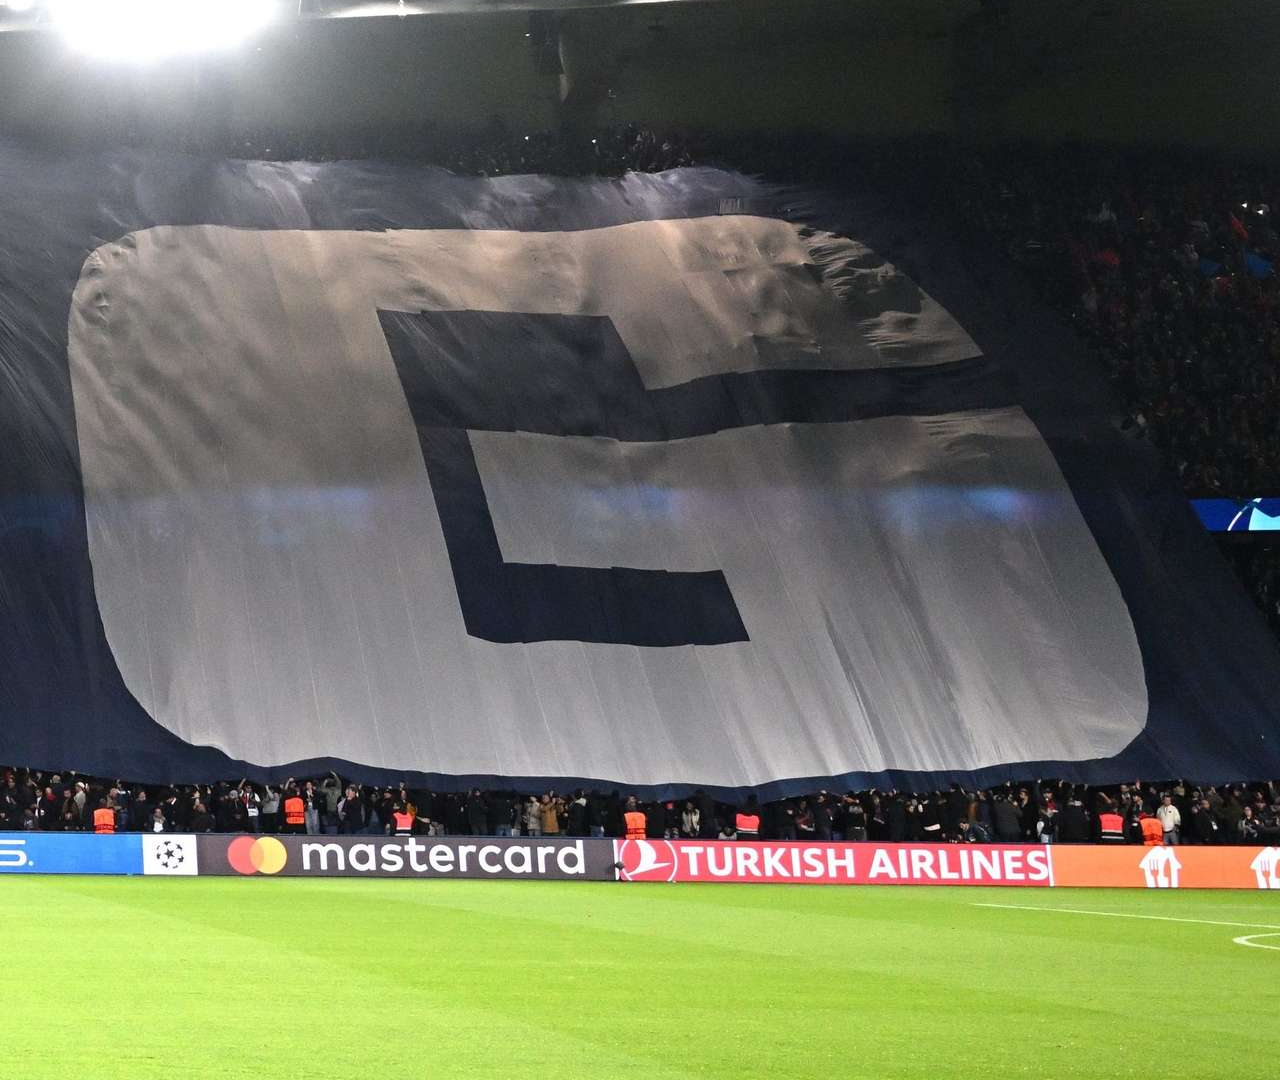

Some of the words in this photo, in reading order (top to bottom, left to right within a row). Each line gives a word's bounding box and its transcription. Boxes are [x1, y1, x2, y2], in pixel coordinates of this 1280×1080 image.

[301, 837, 585, 874] mastercard
[680, 846, 855, 879] TURKISH
[868, 847, 1049, 882] AIRLINES
